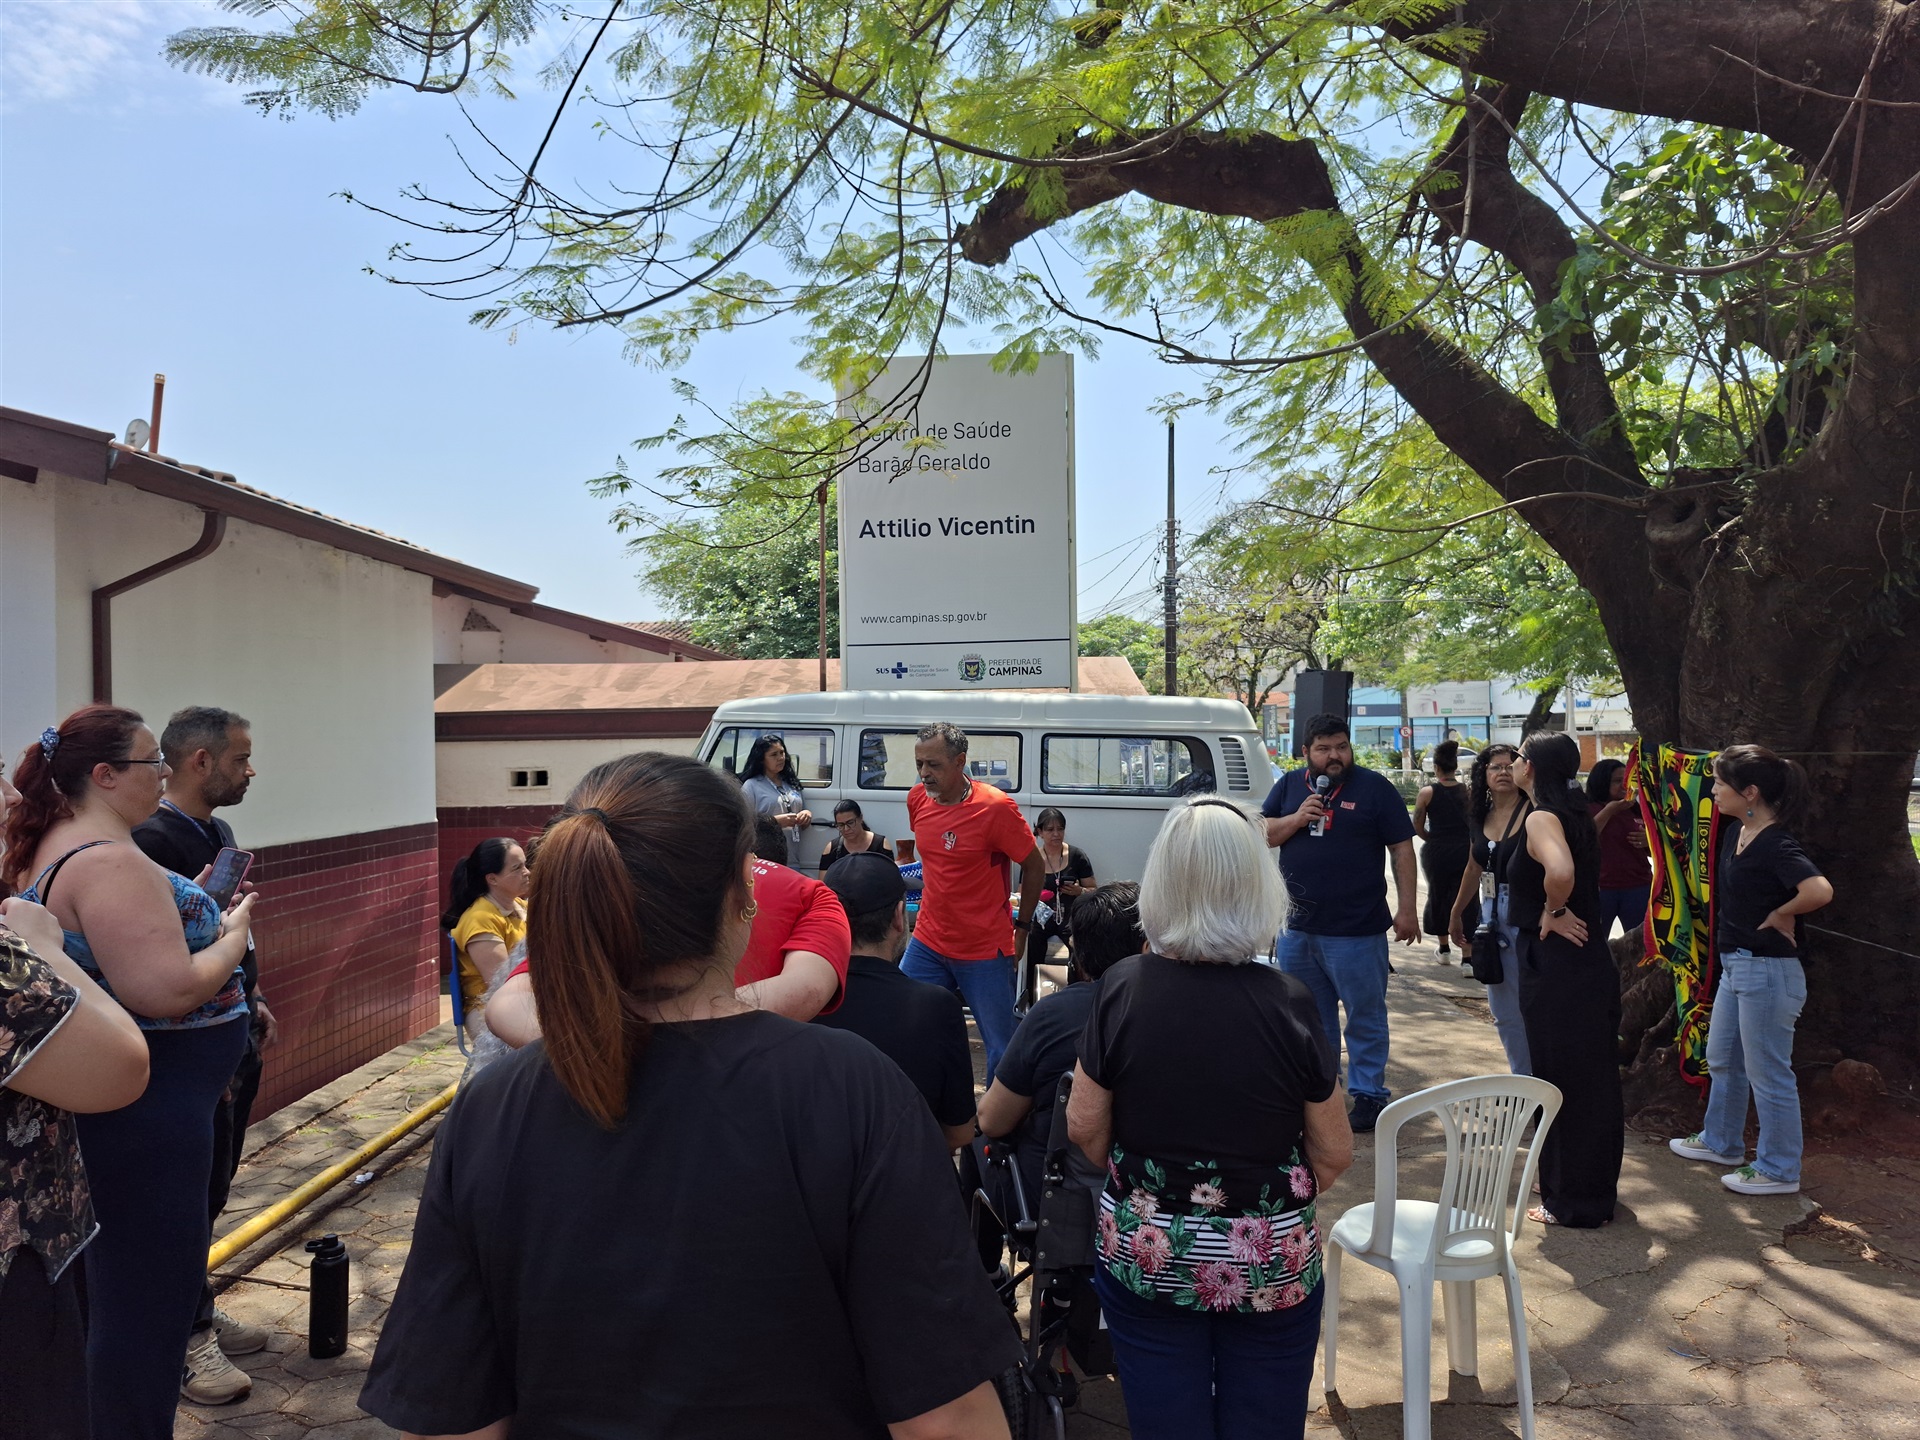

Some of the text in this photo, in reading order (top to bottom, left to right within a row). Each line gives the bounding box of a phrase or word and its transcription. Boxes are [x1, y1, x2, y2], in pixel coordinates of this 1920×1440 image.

[926, 424, 948, 440] de
[953, 420, 1011, 439] Saúde
[858, 453, 990, 473] Barão Geraldo
[858, 514, 1035, 538] Attilio Vicentin
[860, 611, 987, 625] www.campinas.sp.gov.br
[989, 666, 1042, 676] CAMPINAS
